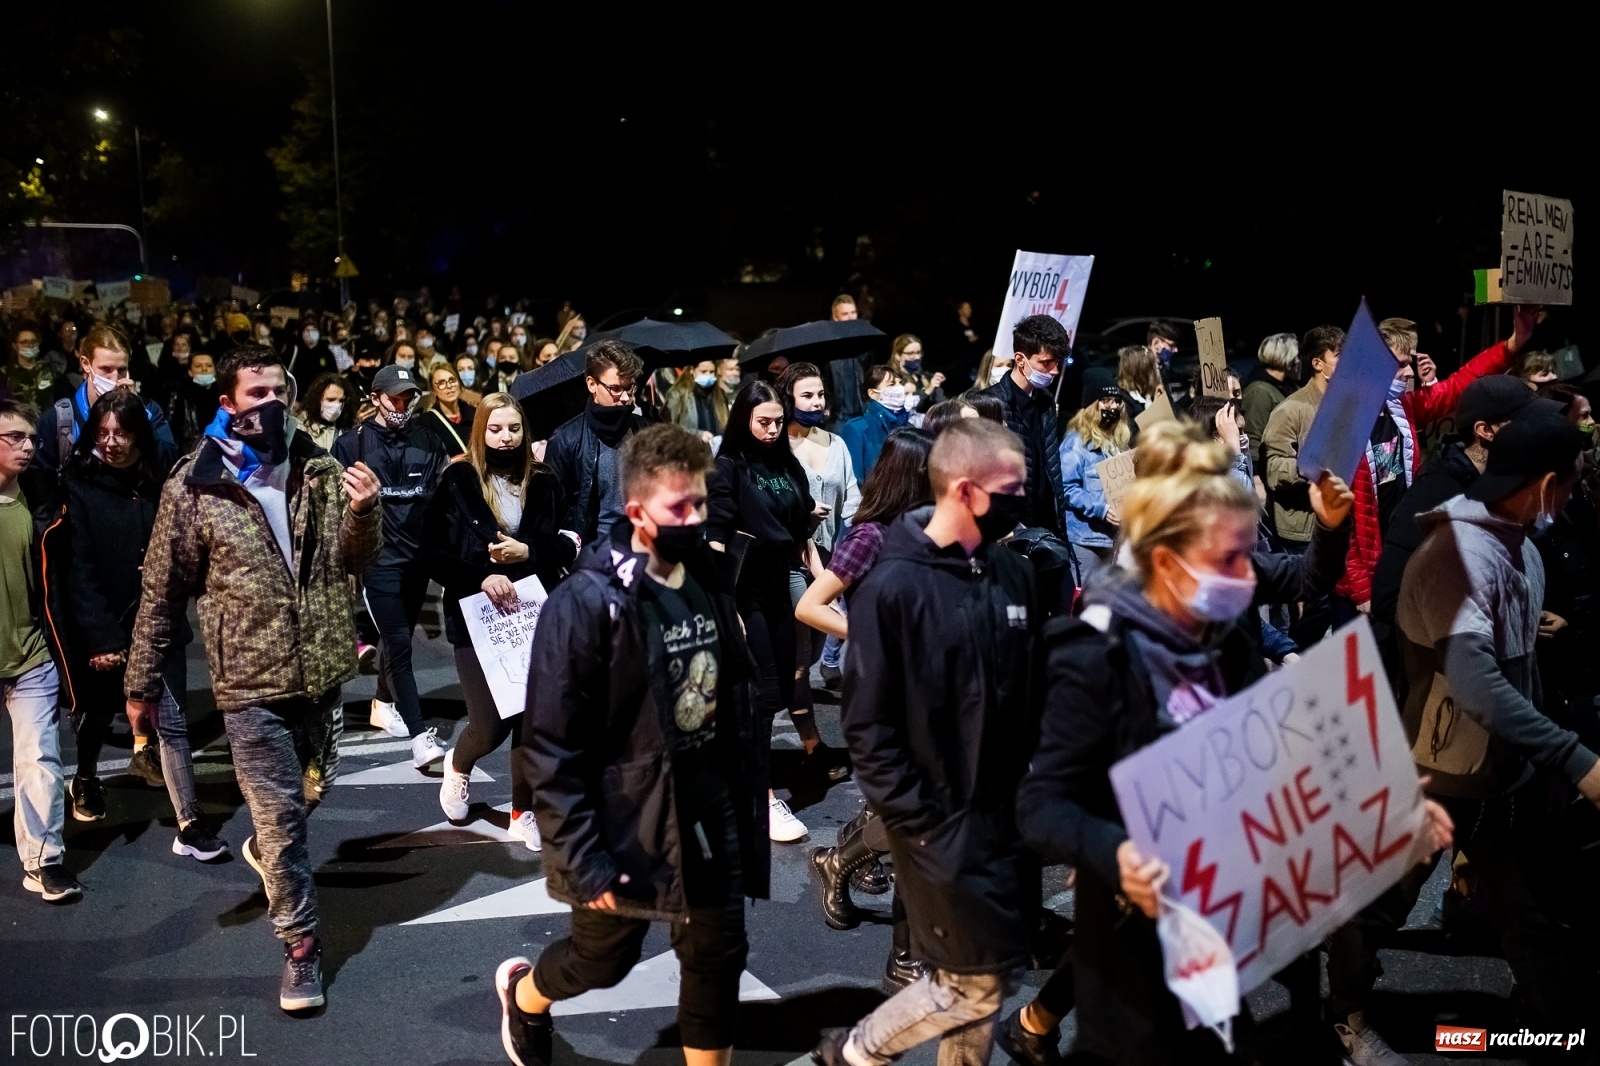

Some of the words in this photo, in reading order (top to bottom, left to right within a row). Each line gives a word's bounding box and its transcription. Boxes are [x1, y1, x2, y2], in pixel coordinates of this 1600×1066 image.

[1507, 195, 1543, 226] REAL
[1545, 203, 1568, 234] MEN
[1008, 267, 1060, 300] WYBÓR
[1505, 255, 1573, 290] FEMINISTS
[480, 613, 496, 625] TAK
[490, 633, 506, 646] SIĘ
[521, 621, 536, 634] NIE
[517, 615, 523, 625] Z
[523, 609, 540, 621] NAS
[1132, 686, 1314, 844] WYBÓR
[1240, 766, 1331, 864] NIE
